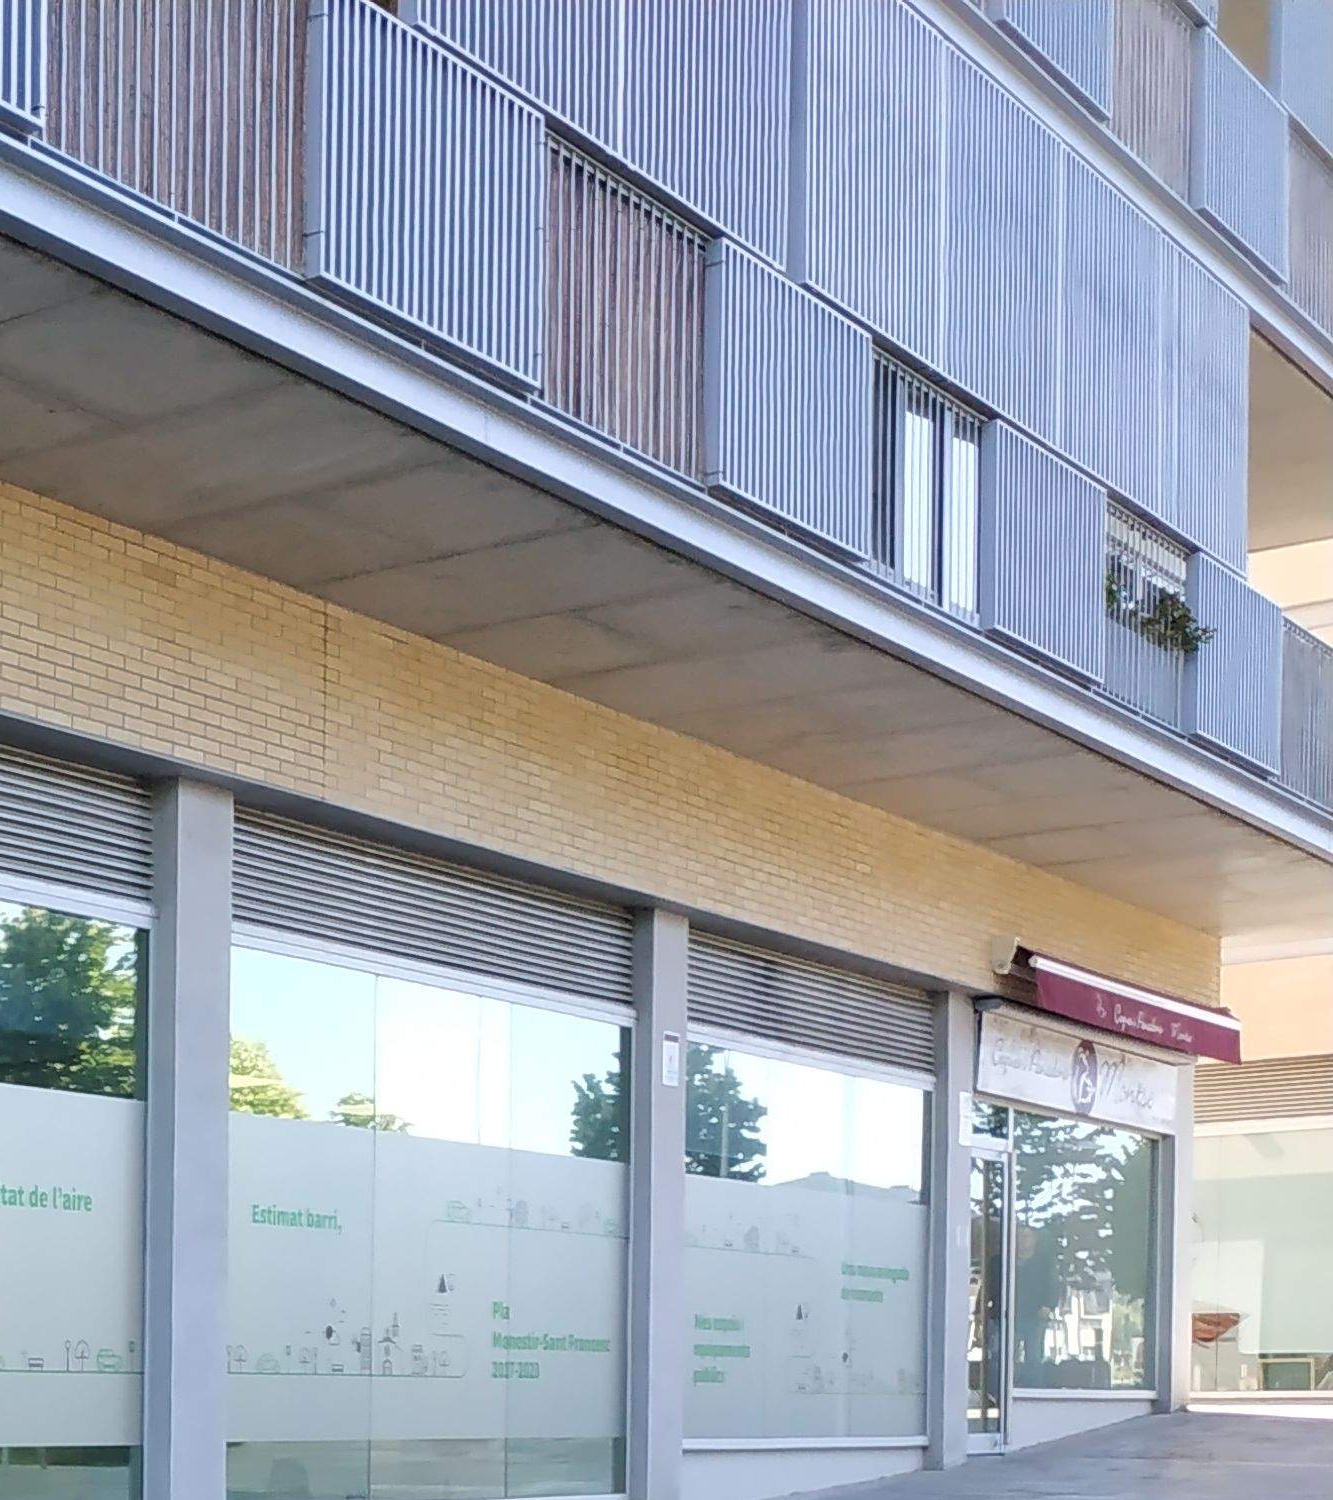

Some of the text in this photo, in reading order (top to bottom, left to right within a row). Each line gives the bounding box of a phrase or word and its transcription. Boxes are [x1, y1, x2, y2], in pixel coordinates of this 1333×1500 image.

[29, 1184, 48, 1208] de
[52, 1186, 93, 1212] l'aire
[252, 1204, 342, 1236] Estimat barri,
